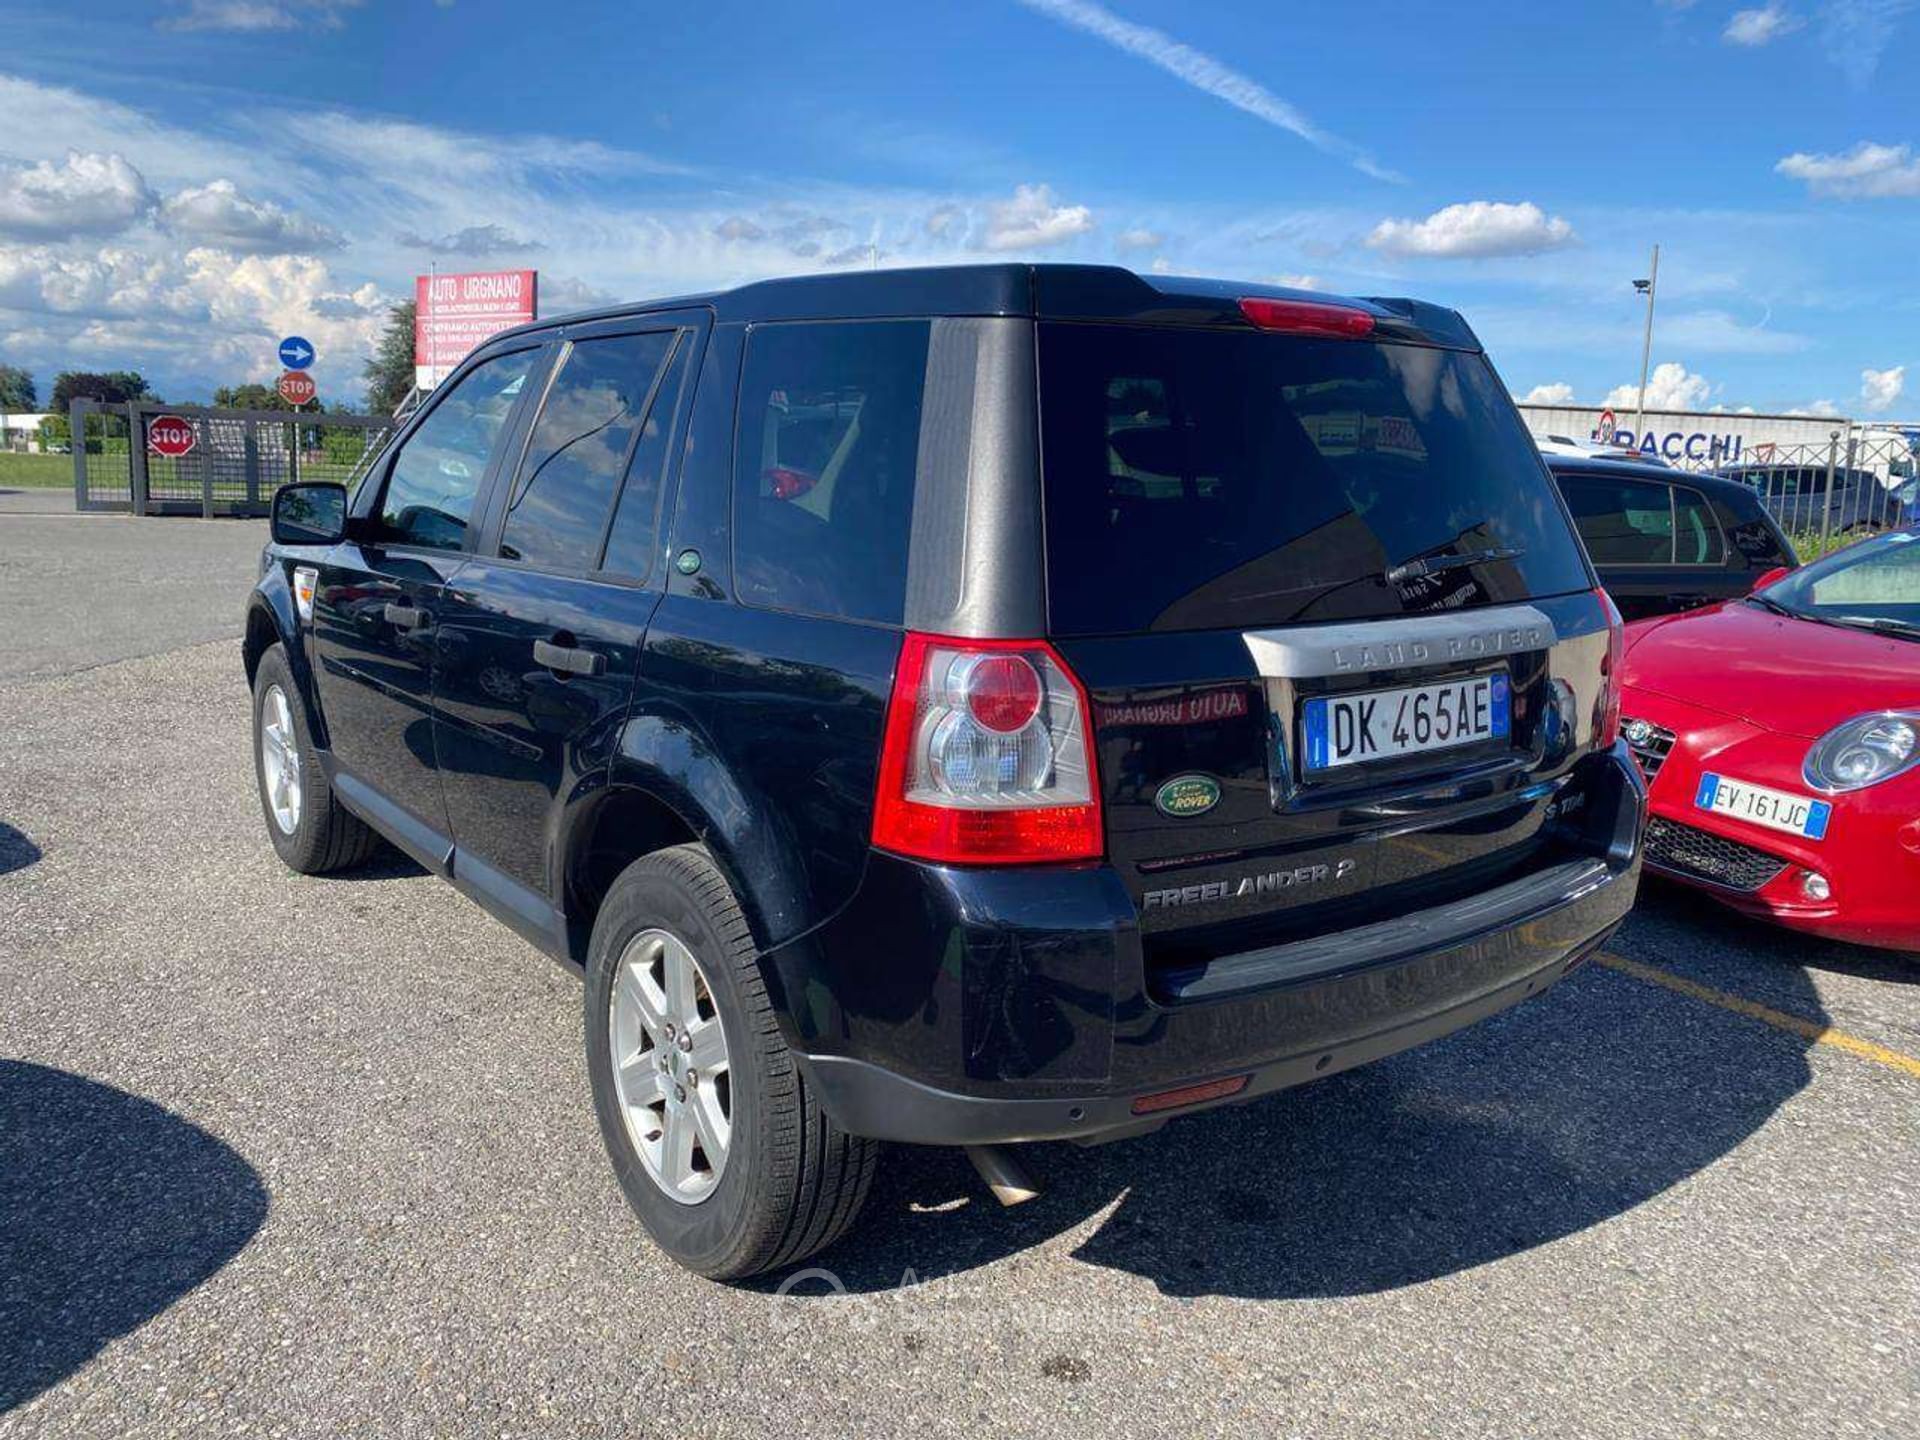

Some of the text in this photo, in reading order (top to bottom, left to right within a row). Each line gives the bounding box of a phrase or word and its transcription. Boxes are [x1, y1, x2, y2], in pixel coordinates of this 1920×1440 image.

[428, 274, 521, 301] AUTO URGNANO
[281, 380, 312, 394] STOP
[151, 428, 192, 445] STOP
[1331, 627, 1542, 671] LAND ROVER
[1334, 681, 1489, 758] DK 465AE
[1174, 795, 1211, 810] ROVER
[1714, 784, 1808, 828] EV 161JC
[1142, 858, 1356, 910] FREELANDER 2
